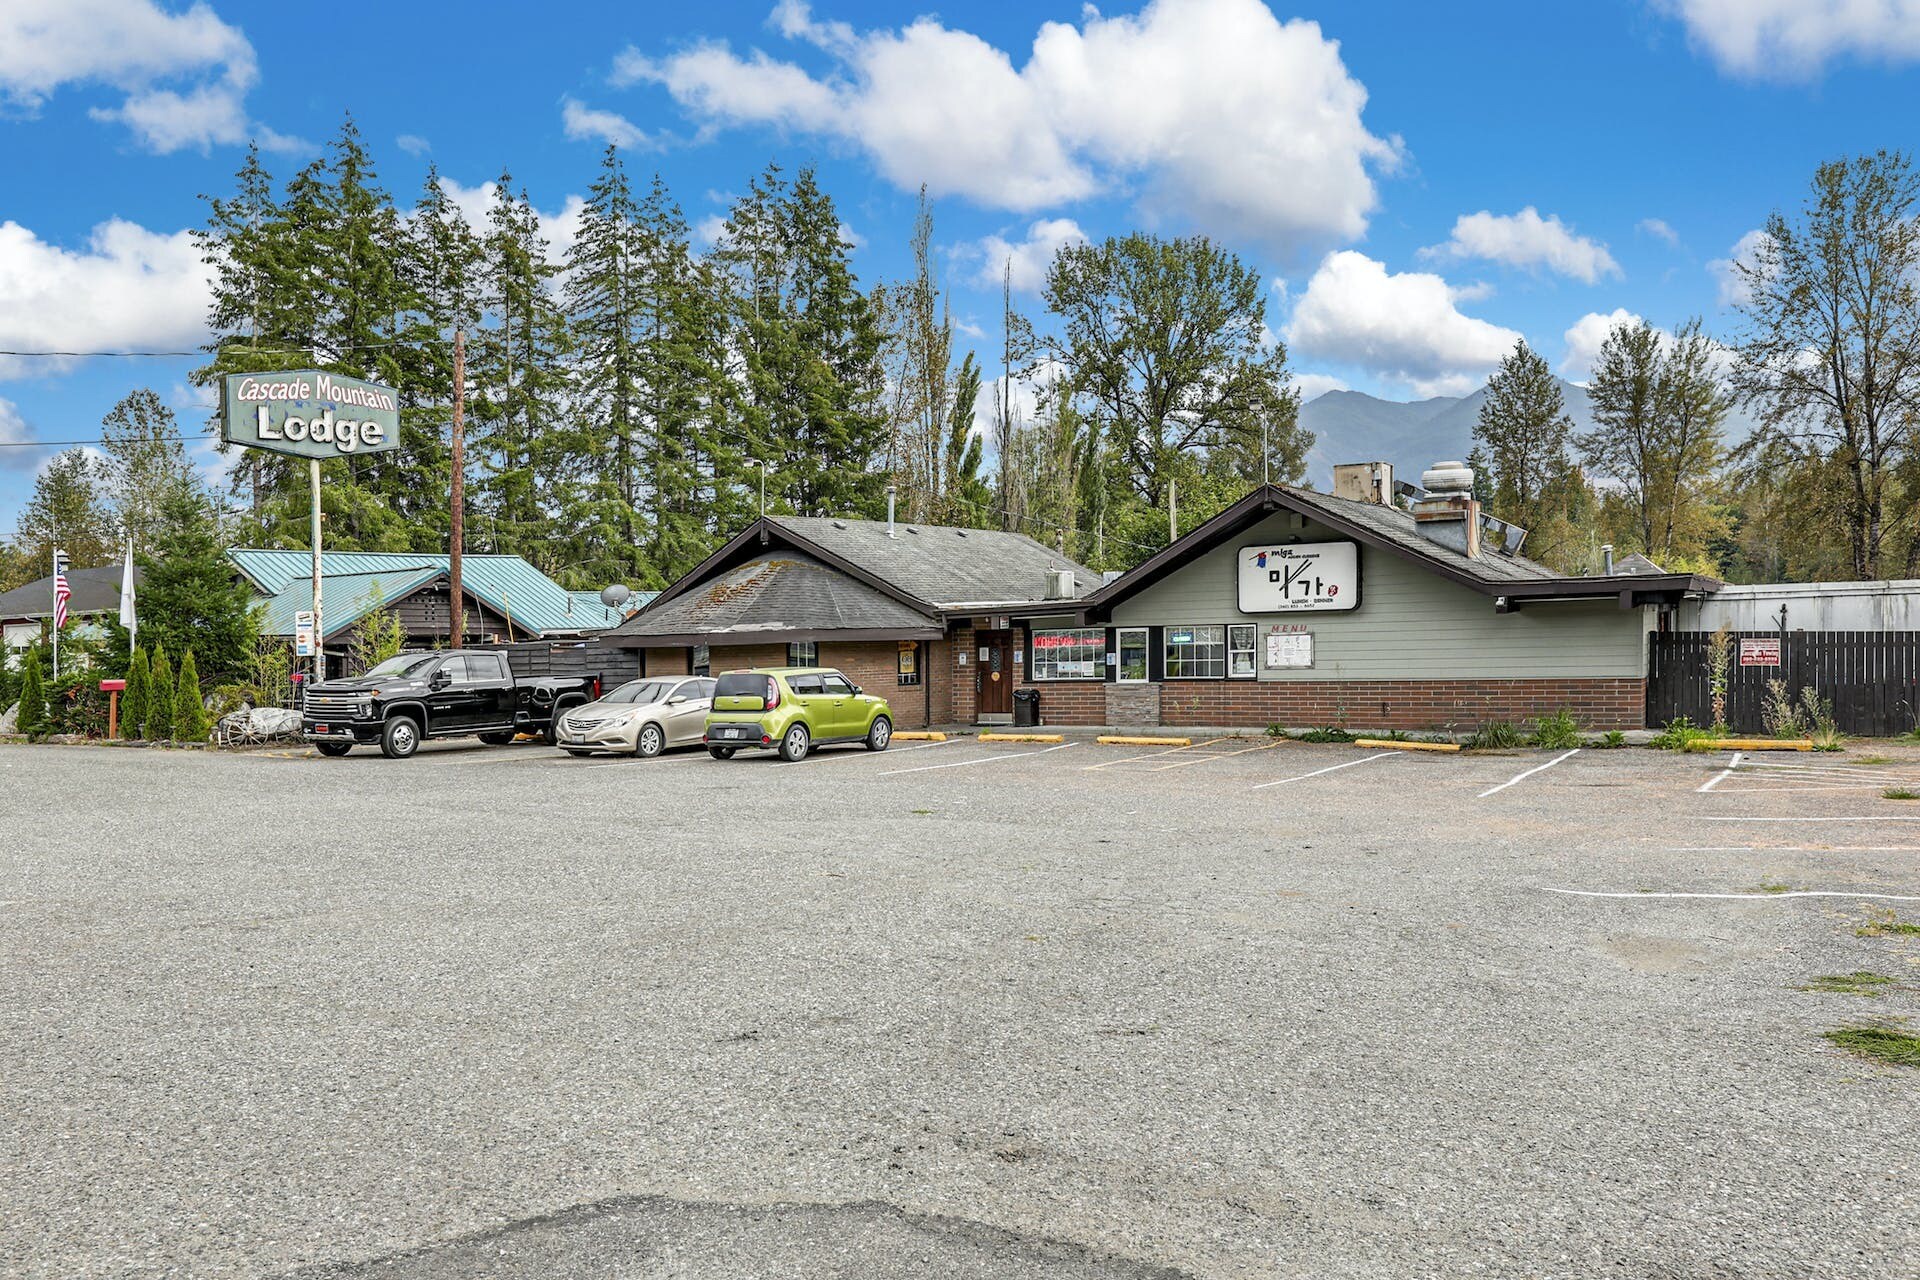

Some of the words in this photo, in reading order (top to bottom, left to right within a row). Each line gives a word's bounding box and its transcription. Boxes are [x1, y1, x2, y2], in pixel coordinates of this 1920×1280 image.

[237, 377, 311, 401] Cascade
[316, 374, 394, 411] Mountain
[257, 404, 384, 453] Lodge
[1269, 562, 1324, 599] 미가
[1271, 624, 1307, 633] MENU
